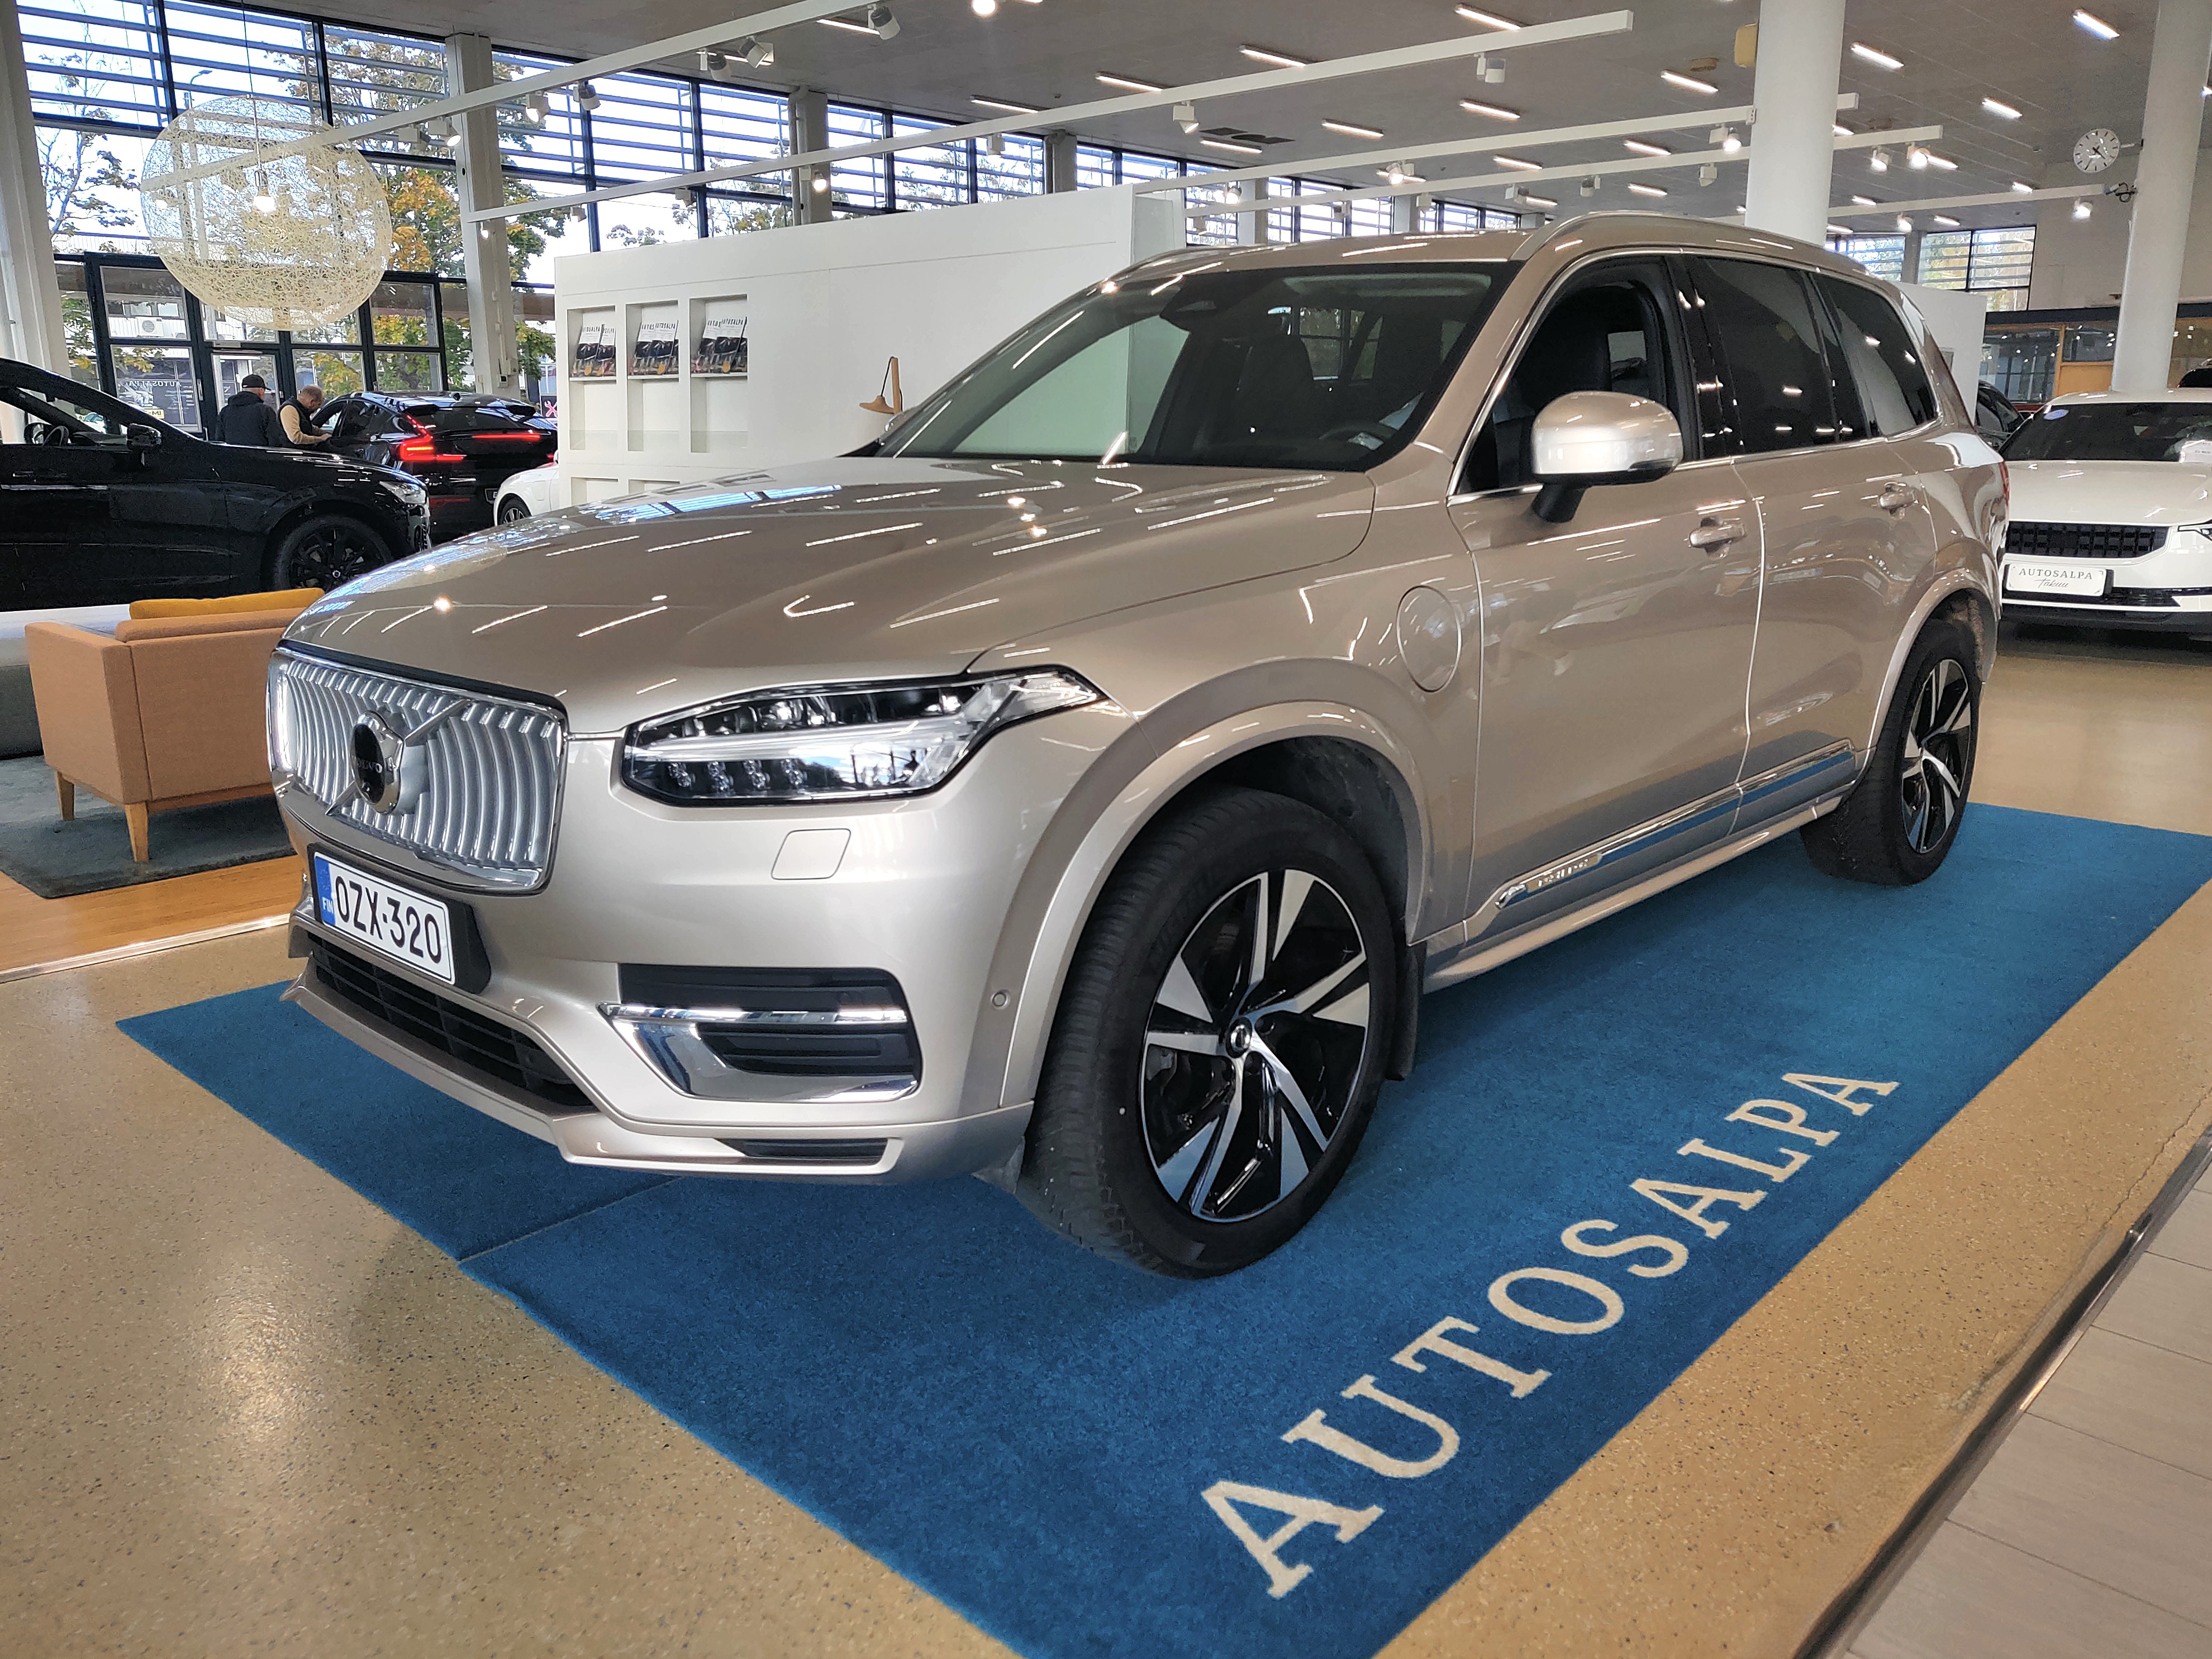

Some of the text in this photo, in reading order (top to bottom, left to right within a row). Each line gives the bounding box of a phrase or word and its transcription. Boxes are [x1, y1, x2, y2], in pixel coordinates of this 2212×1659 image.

[2018, 568, 2093, 580] AUTOSALPA
[322, 896, 334, 915] FIN
[335, 875, 442, 964] OZX-320
[1201, 1072, 1899, 1599] AUTOSALPA
